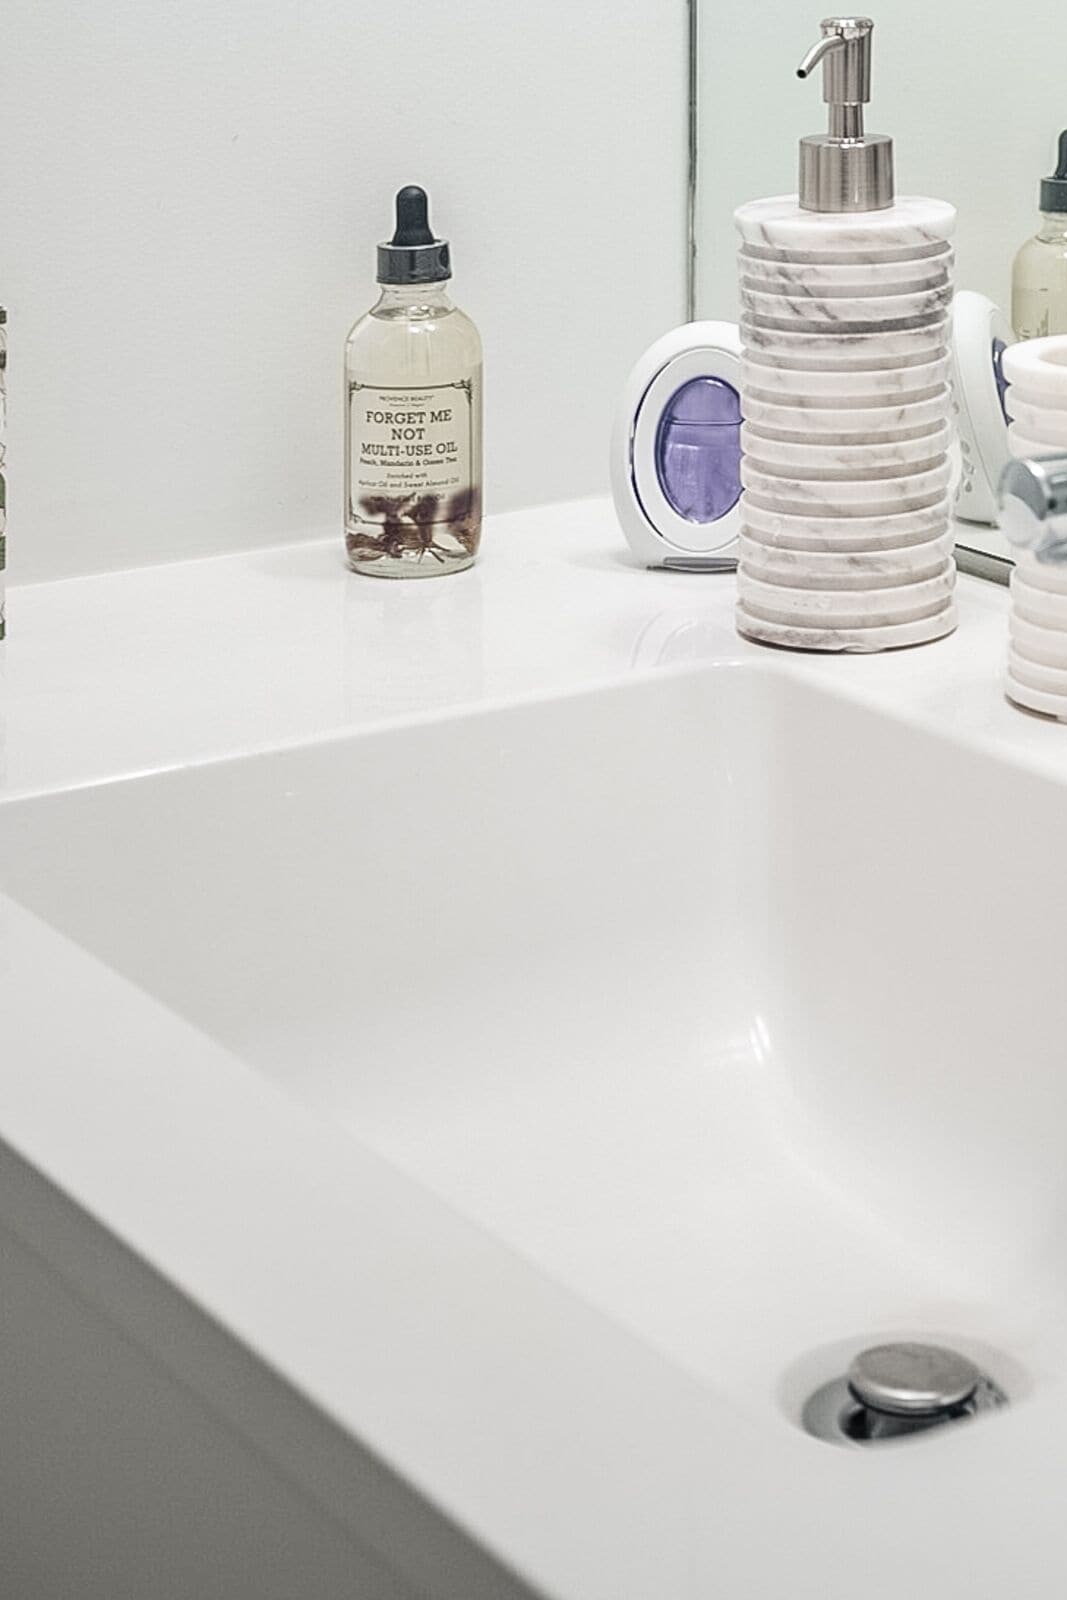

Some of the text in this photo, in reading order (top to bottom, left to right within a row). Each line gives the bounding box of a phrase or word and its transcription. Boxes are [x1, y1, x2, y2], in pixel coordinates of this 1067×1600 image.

[366, 409, 452, 424] FORGET ME
[391, 428, 426, 440] NOT
[361, 442, 458, 456] MULTI-USE OIL
